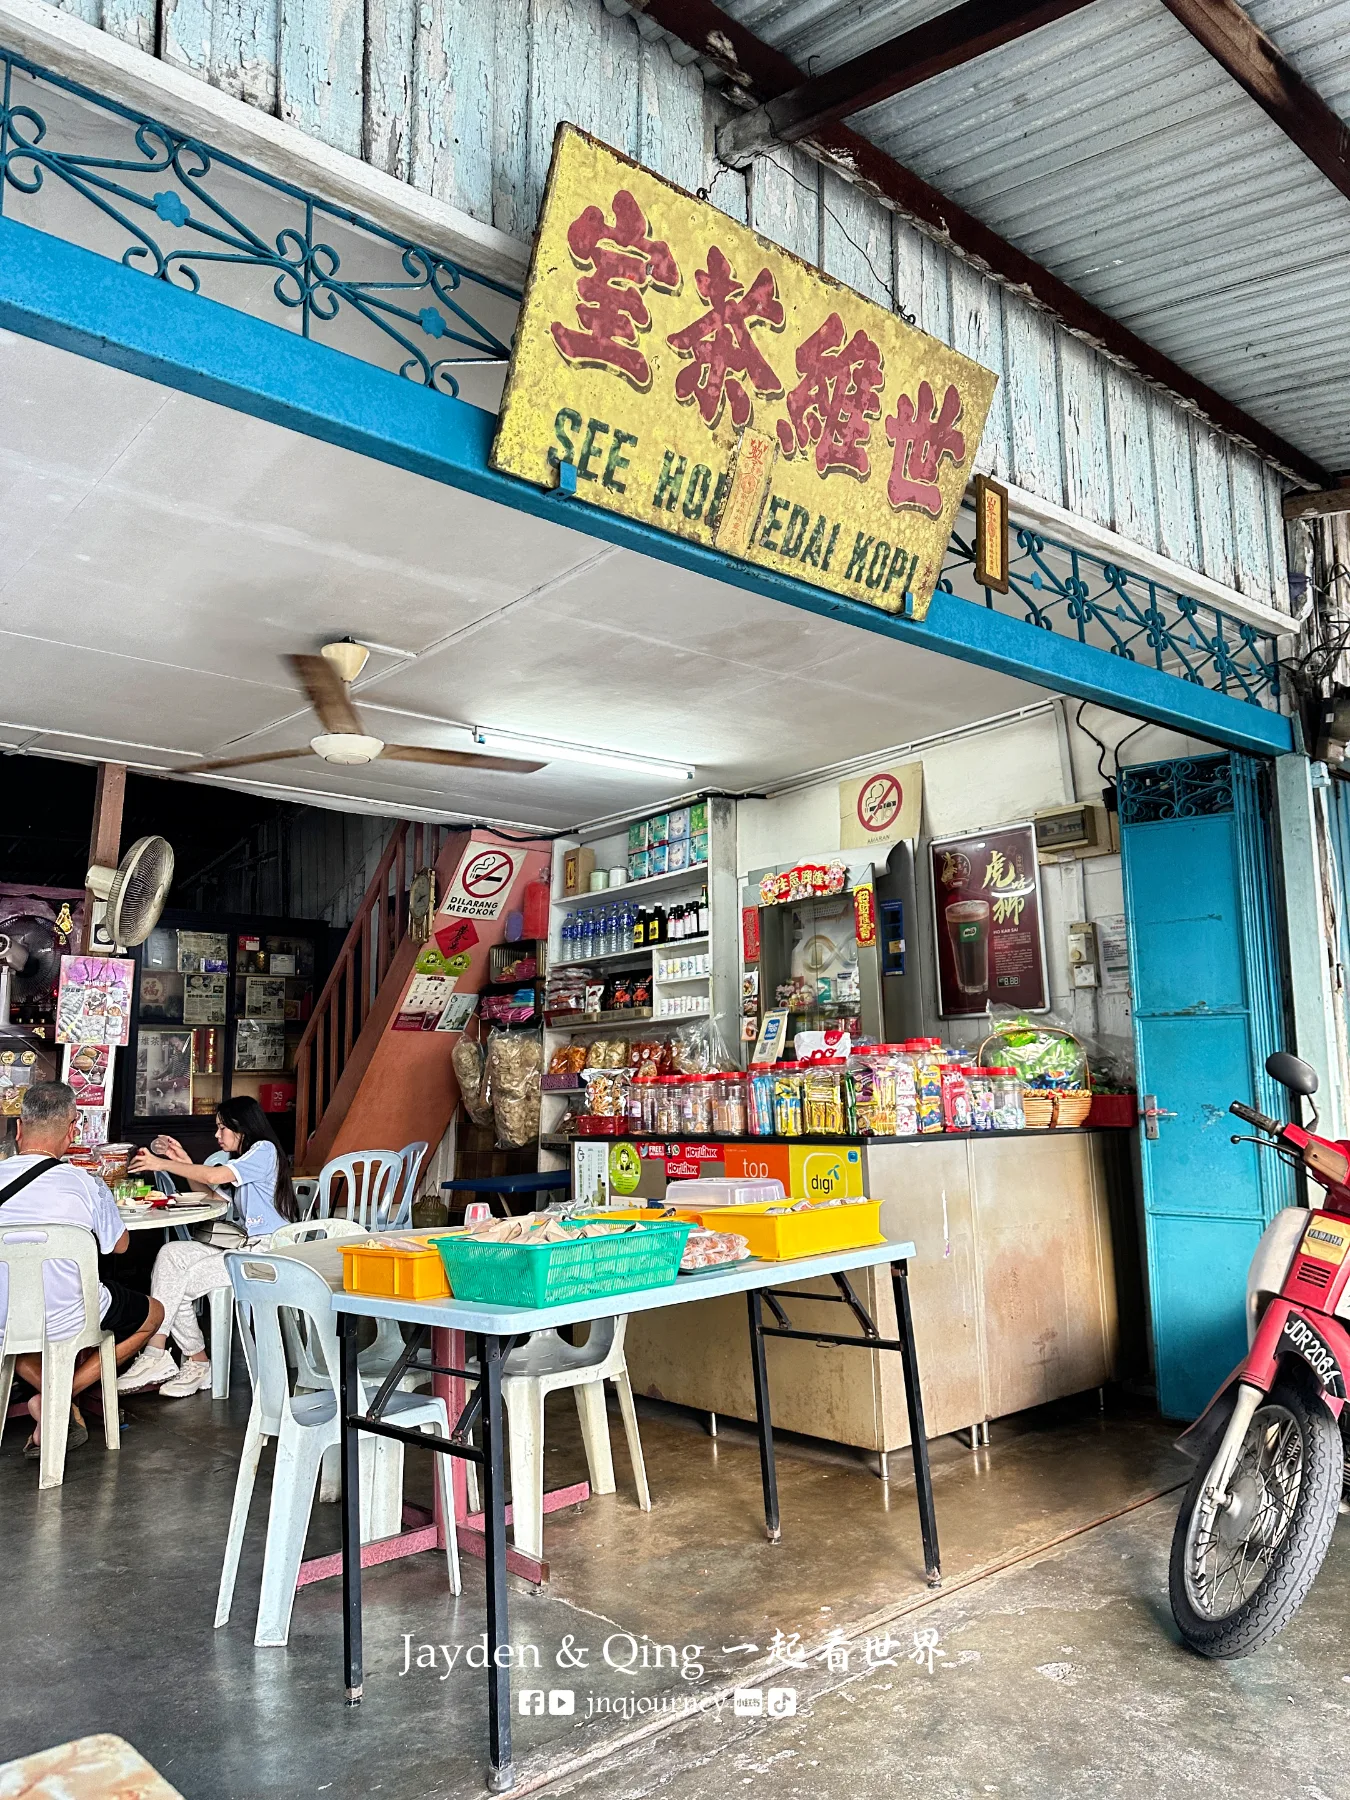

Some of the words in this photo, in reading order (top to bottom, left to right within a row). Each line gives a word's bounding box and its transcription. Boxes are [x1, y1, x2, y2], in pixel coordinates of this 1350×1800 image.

[547, 407, 639, 494] SEE
[845, 531, 920, 594] KOPI
[446, 903, 496, 916] MEROKOK
[450, 896, 498, 909] DILARANG
[742, 1158, 768, 1178] top
[811, 1174, 834, 1194] digi
[1307, 1228, 1344, 1247] YAMAHA
[1284, 1319, 1341, 1386] JDR2064
